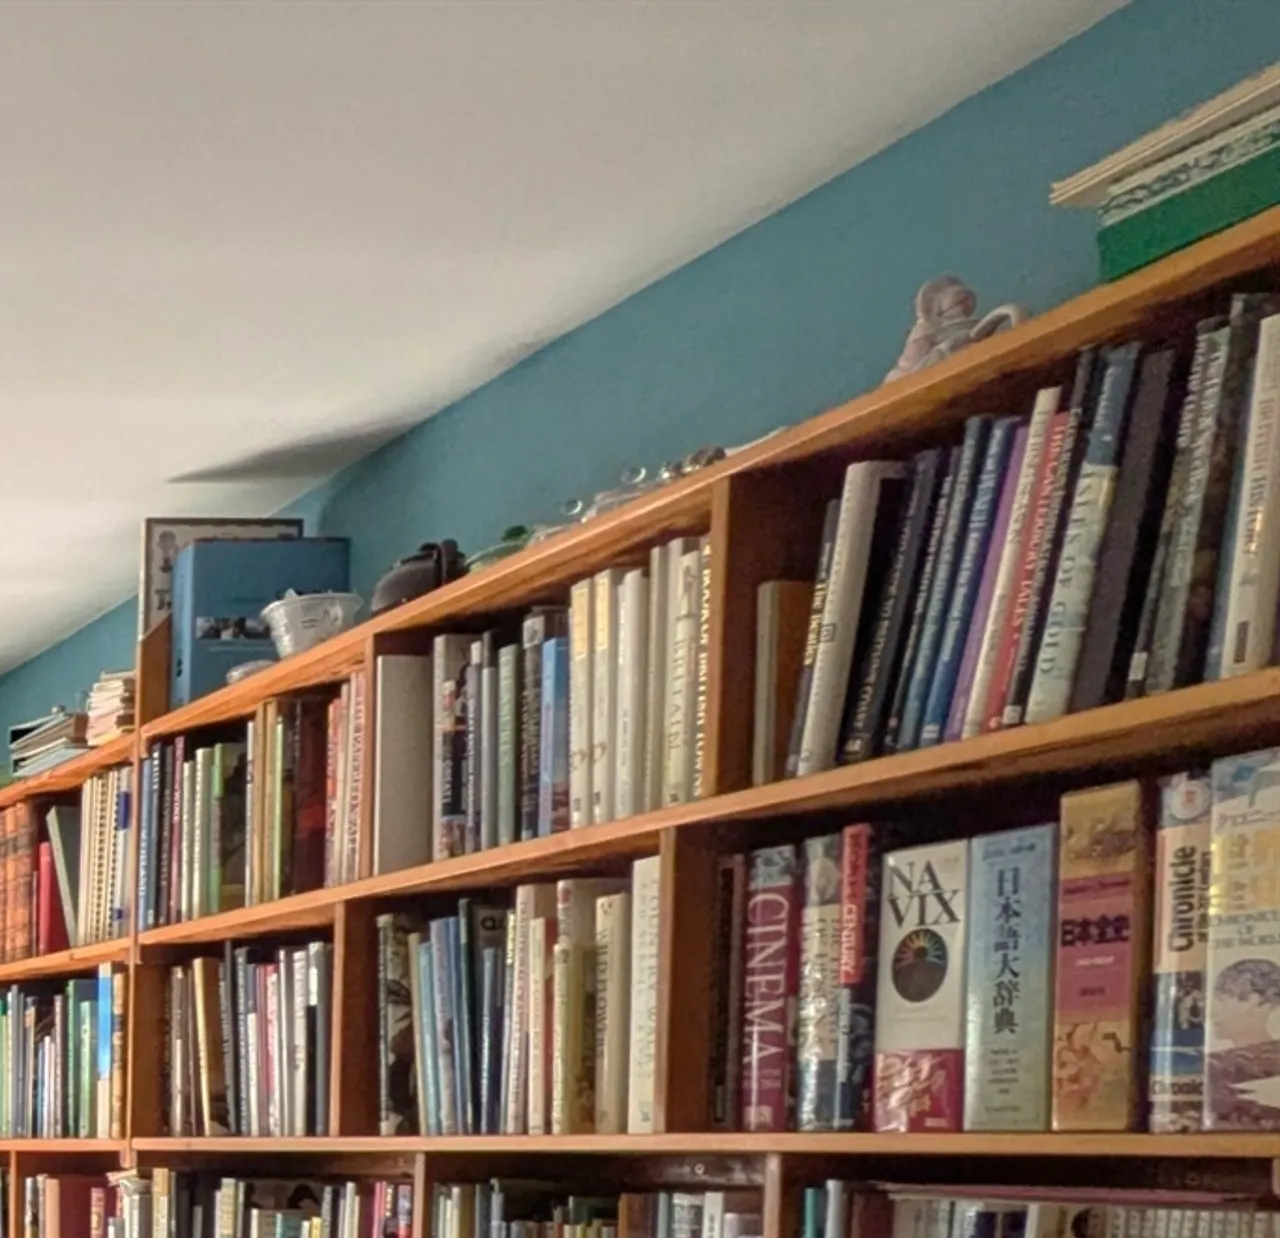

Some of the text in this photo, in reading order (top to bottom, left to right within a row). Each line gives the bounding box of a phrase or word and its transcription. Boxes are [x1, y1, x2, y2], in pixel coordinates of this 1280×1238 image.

[1022, 459, 1060, 571] CANTERBURY
[1009, 577, 1033, 628] TALES
[1057, 554, 1076, 589] OF
[1039, 599, 1067, 676] GOLD
[669, 638, 688, 750] BRITAIN
[696, 652, 708, 725] BRITISH
[693, 732, 705, 797] TOWNS
[1170, 845, 1197, 952] Chronicle
[841, 903, 858, 976] CENTURY
[742, 892, 789, 1065] CINEMA
